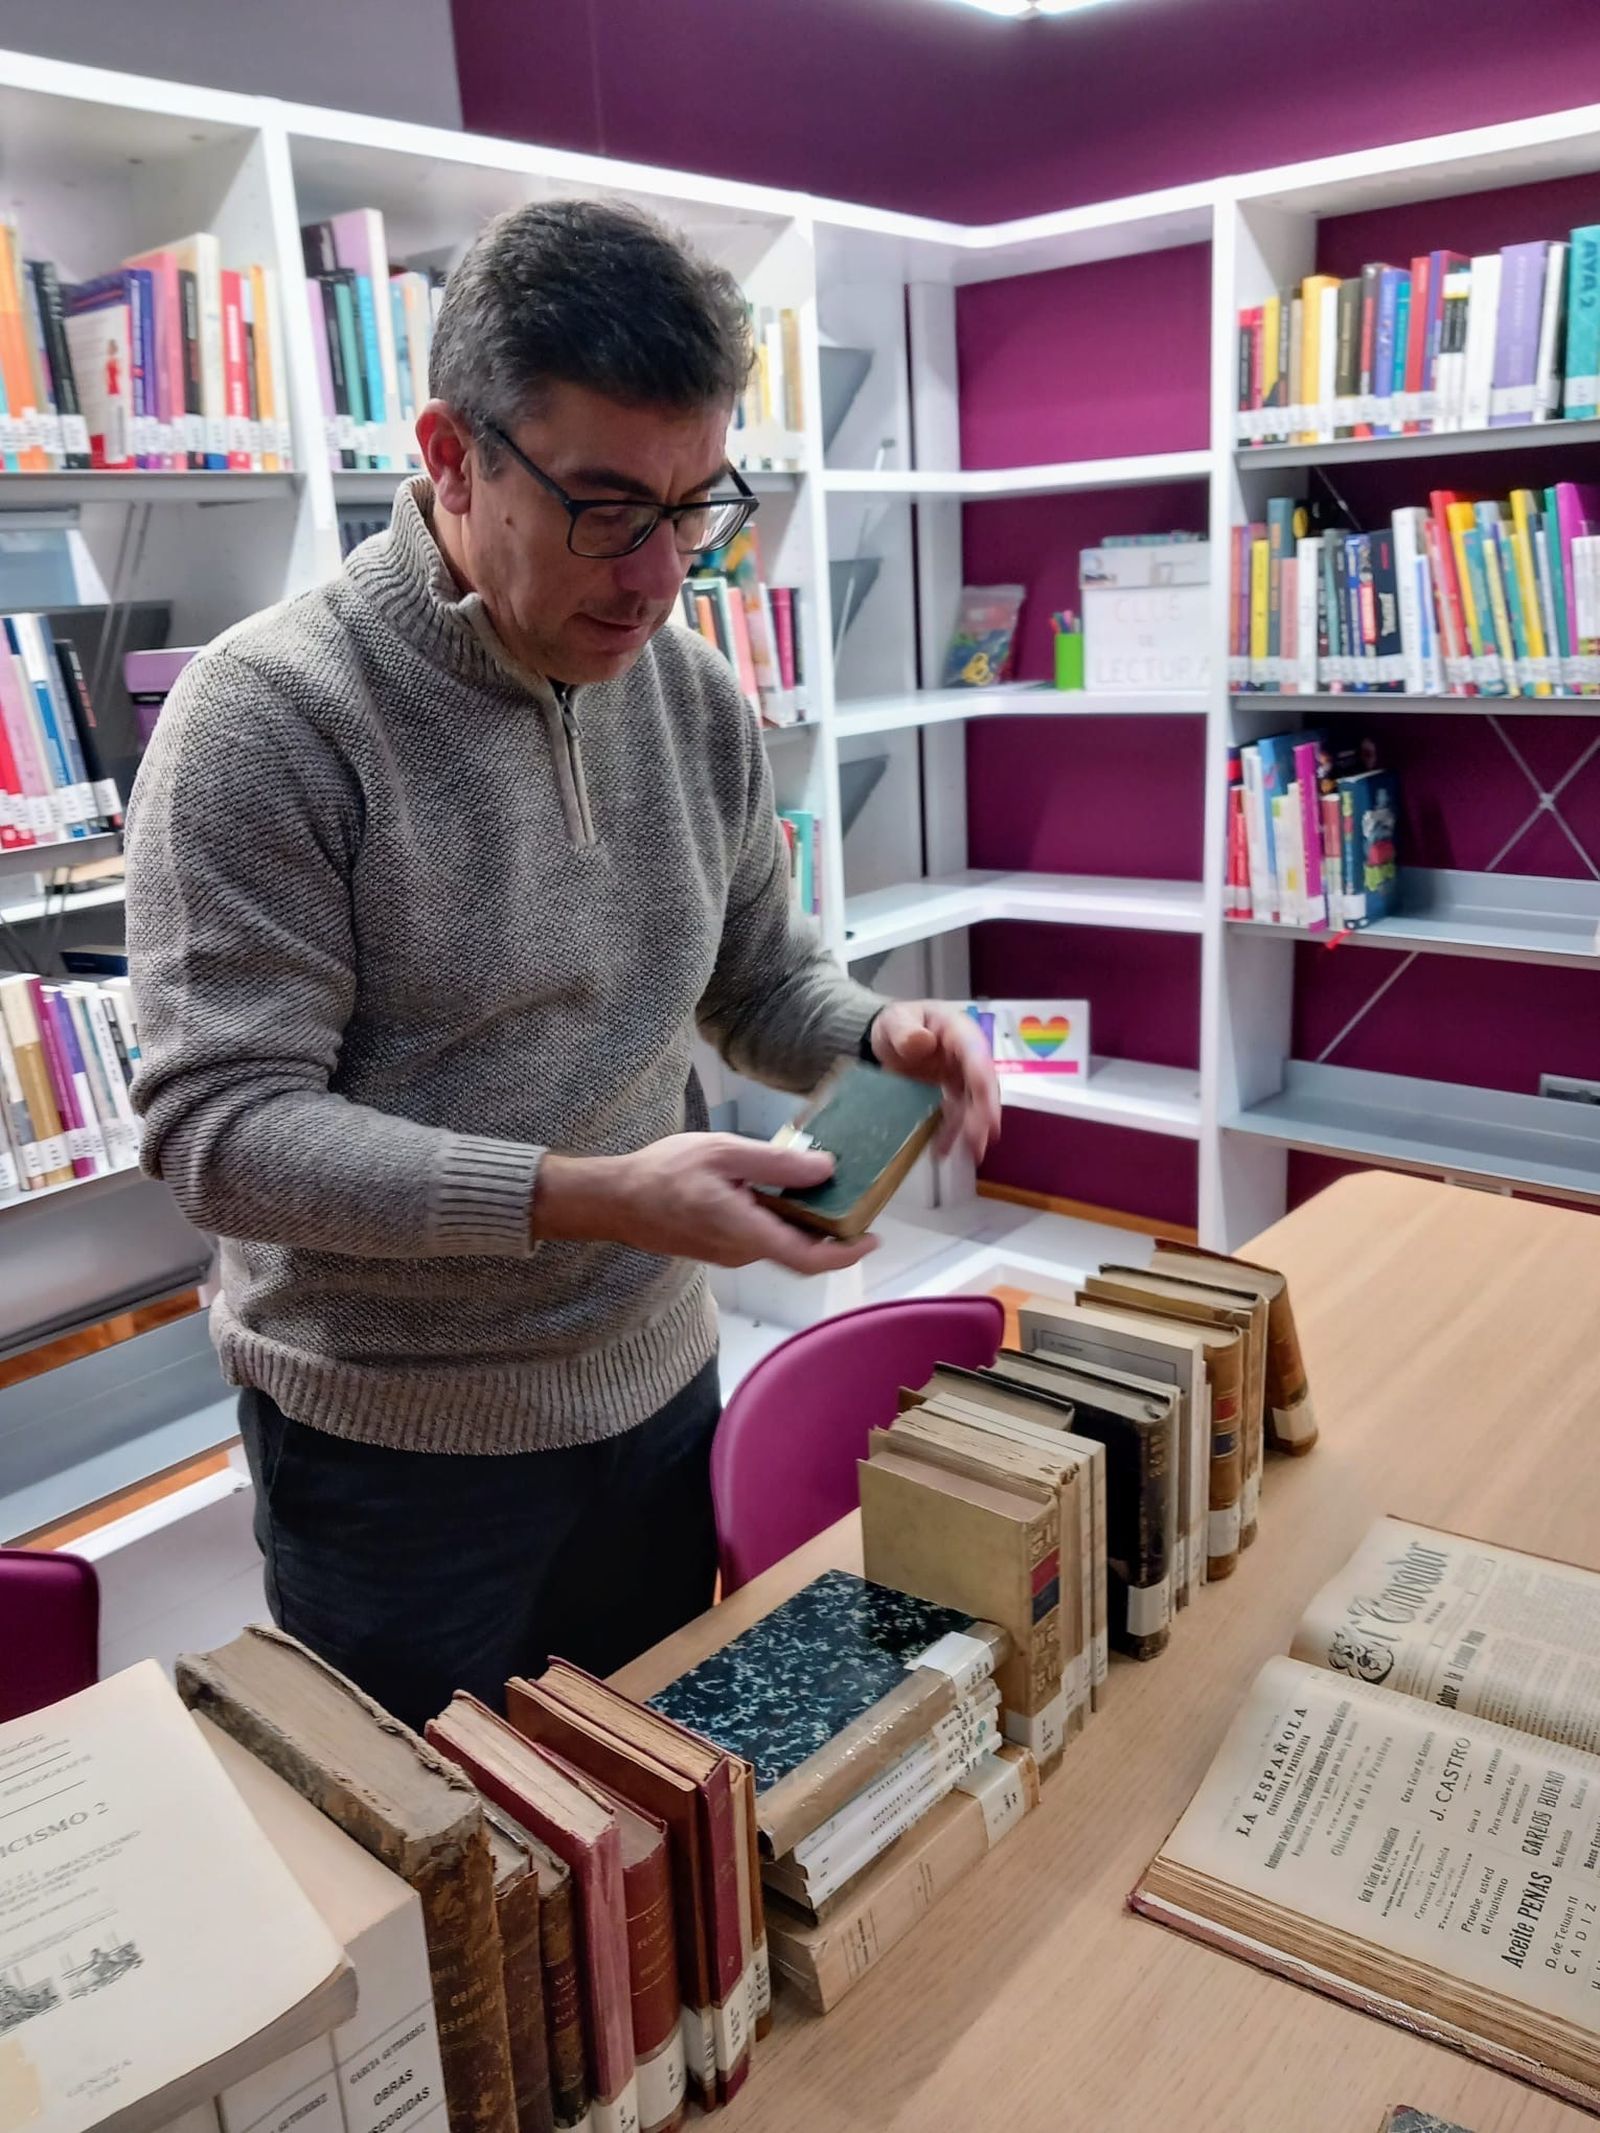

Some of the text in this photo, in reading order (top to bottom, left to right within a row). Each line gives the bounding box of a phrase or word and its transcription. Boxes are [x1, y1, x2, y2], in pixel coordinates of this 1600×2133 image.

[1235, 1814, 1259, 1837] LA
[1252, 1709, 1308, 1803] ESPAÑOLA
[1429, 1738, 1471, 1822] J. CASTRO
[1521, 1770, 1565, 1857] CARLOS BUENO
[1460, 1866, 1495, 1933] Pruebe usted
[1480, 1923, 1492, 1935] el
[1500, 1871, 1553, 1969] Aceite PEÑAS
[1544, 1957, 1559, 1969] D.
[1550, 1942, 1564, 1956] de
[373, 2068, 414, 2106] OBRAS
